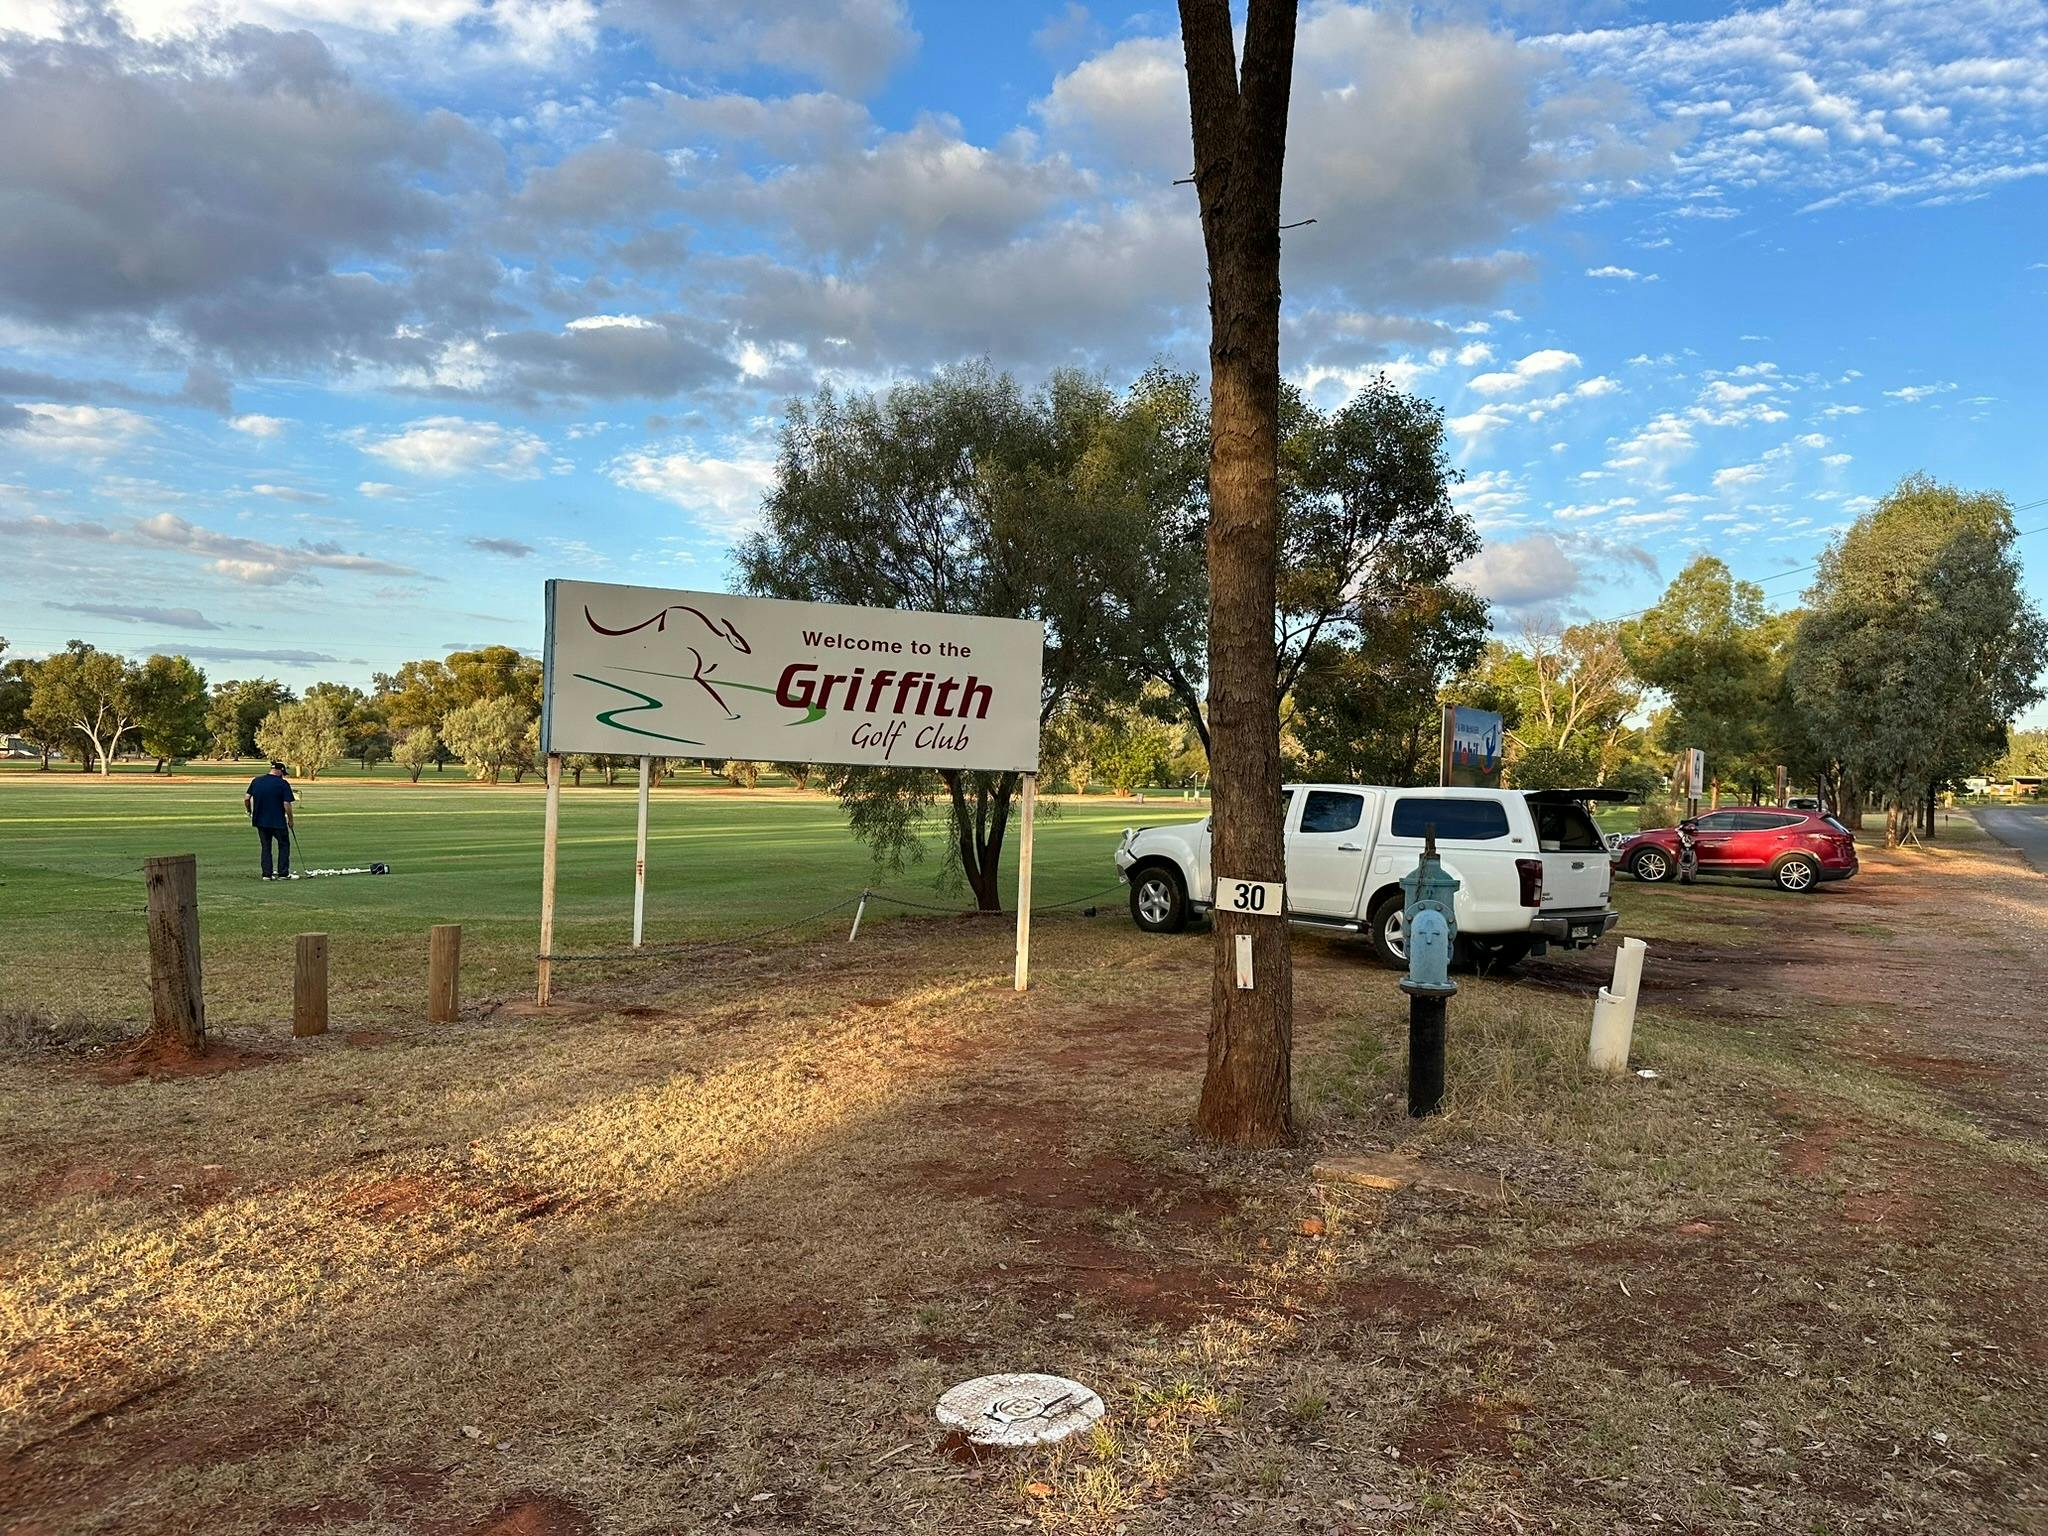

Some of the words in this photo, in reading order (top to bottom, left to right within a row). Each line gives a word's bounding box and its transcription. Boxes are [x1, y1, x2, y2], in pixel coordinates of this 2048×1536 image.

[802, 630, 903, 654] Welcome
[911, 640, 932, 655] to
[938, 642, 972, 658] the
[775, 663, 993, 719] Griffith
[851, 719, 907, 760] Golf
[914, 722, 969, 751] Club
[1233, 883, 1266, 911] 30
